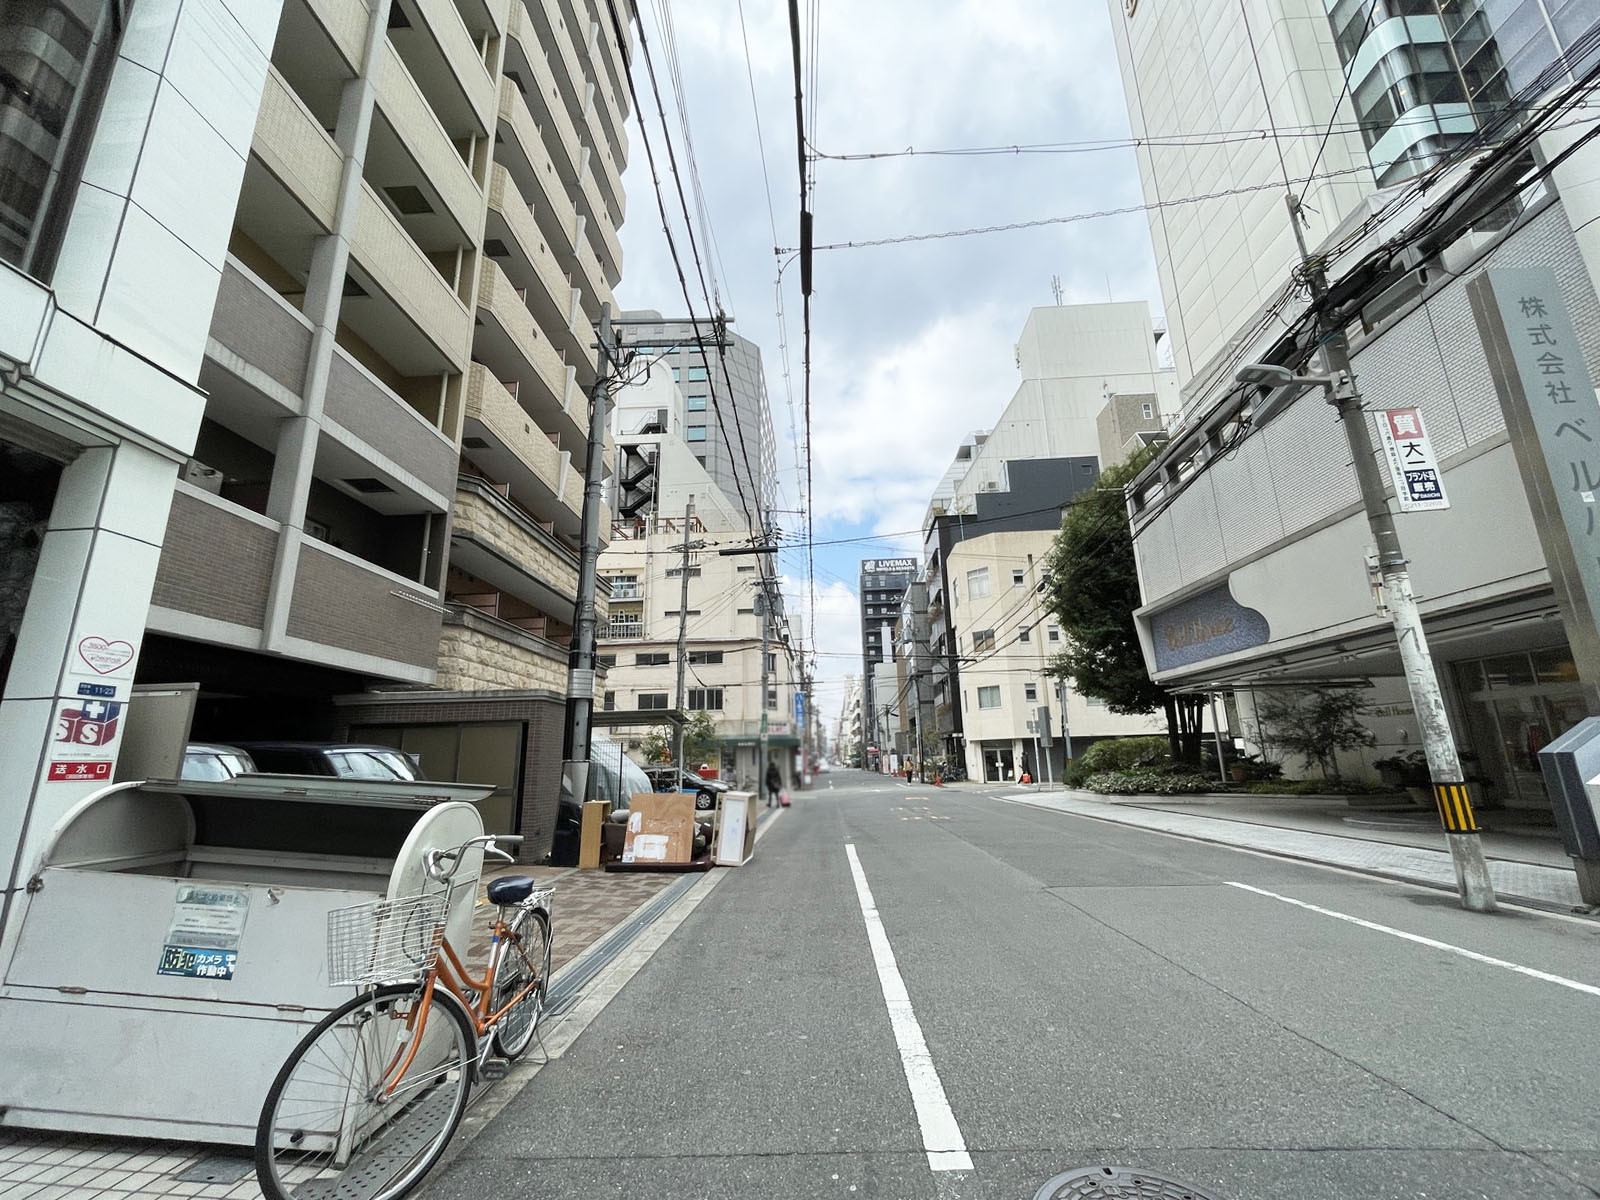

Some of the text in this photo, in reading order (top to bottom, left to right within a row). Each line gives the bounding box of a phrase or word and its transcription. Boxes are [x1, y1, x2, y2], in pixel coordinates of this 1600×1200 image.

[1402, 441, 1426, 465] 大一
[1406, 470, 1436, 482] ブランド品
[879, 560, 912, 568] LIVEMAX
[55, 764, 106, 774] 送水口
[197, 954, 222, 965] カメラ
[196, 965, 227, 977] 作動中
